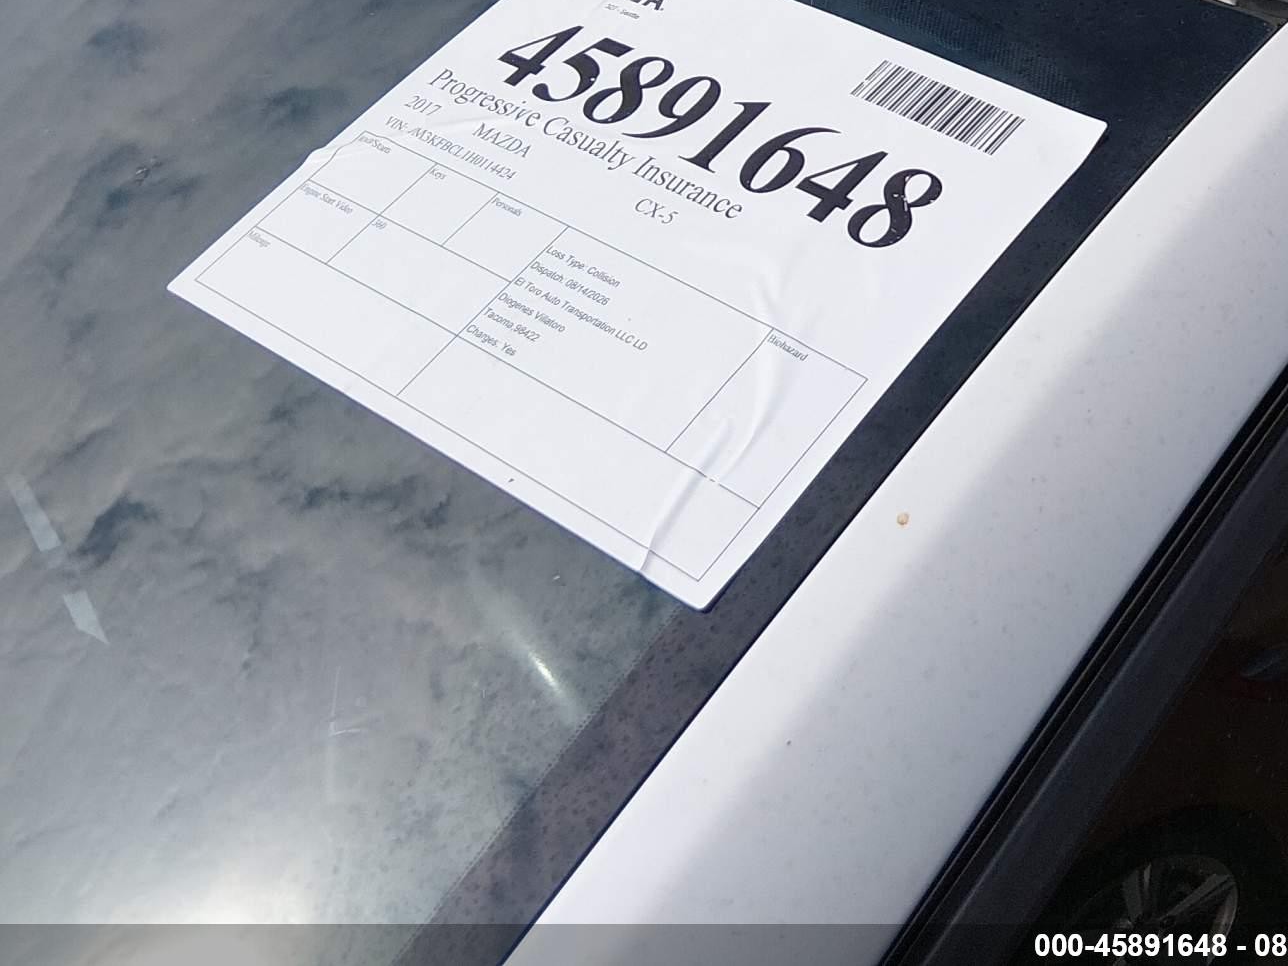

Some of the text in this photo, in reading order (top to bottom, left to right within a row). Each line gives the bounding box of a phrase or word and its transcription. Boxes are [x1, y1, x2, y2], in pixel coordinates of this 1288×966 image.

[428, 68, 744, 218] Progressive Casualty Insurance
[498, 26, 942, 248] 45891648
[404, 96, 679, 225] 2017 MAZDA CX-5
[429, 168, 447, 180] Keys
[546, 245, 567, 260] Loss
[585, 267, 620, 288] Collision
[496, 292, 565, 332] Diogenes Villatoro
[565, 279, 610, 306] 08/14/2026
[514, 277, 648, 350] El Toro Auto Transportation LLC LD
[501, 342, 517, 356] Yes
[767, 334, 808, 361] Biohazard
